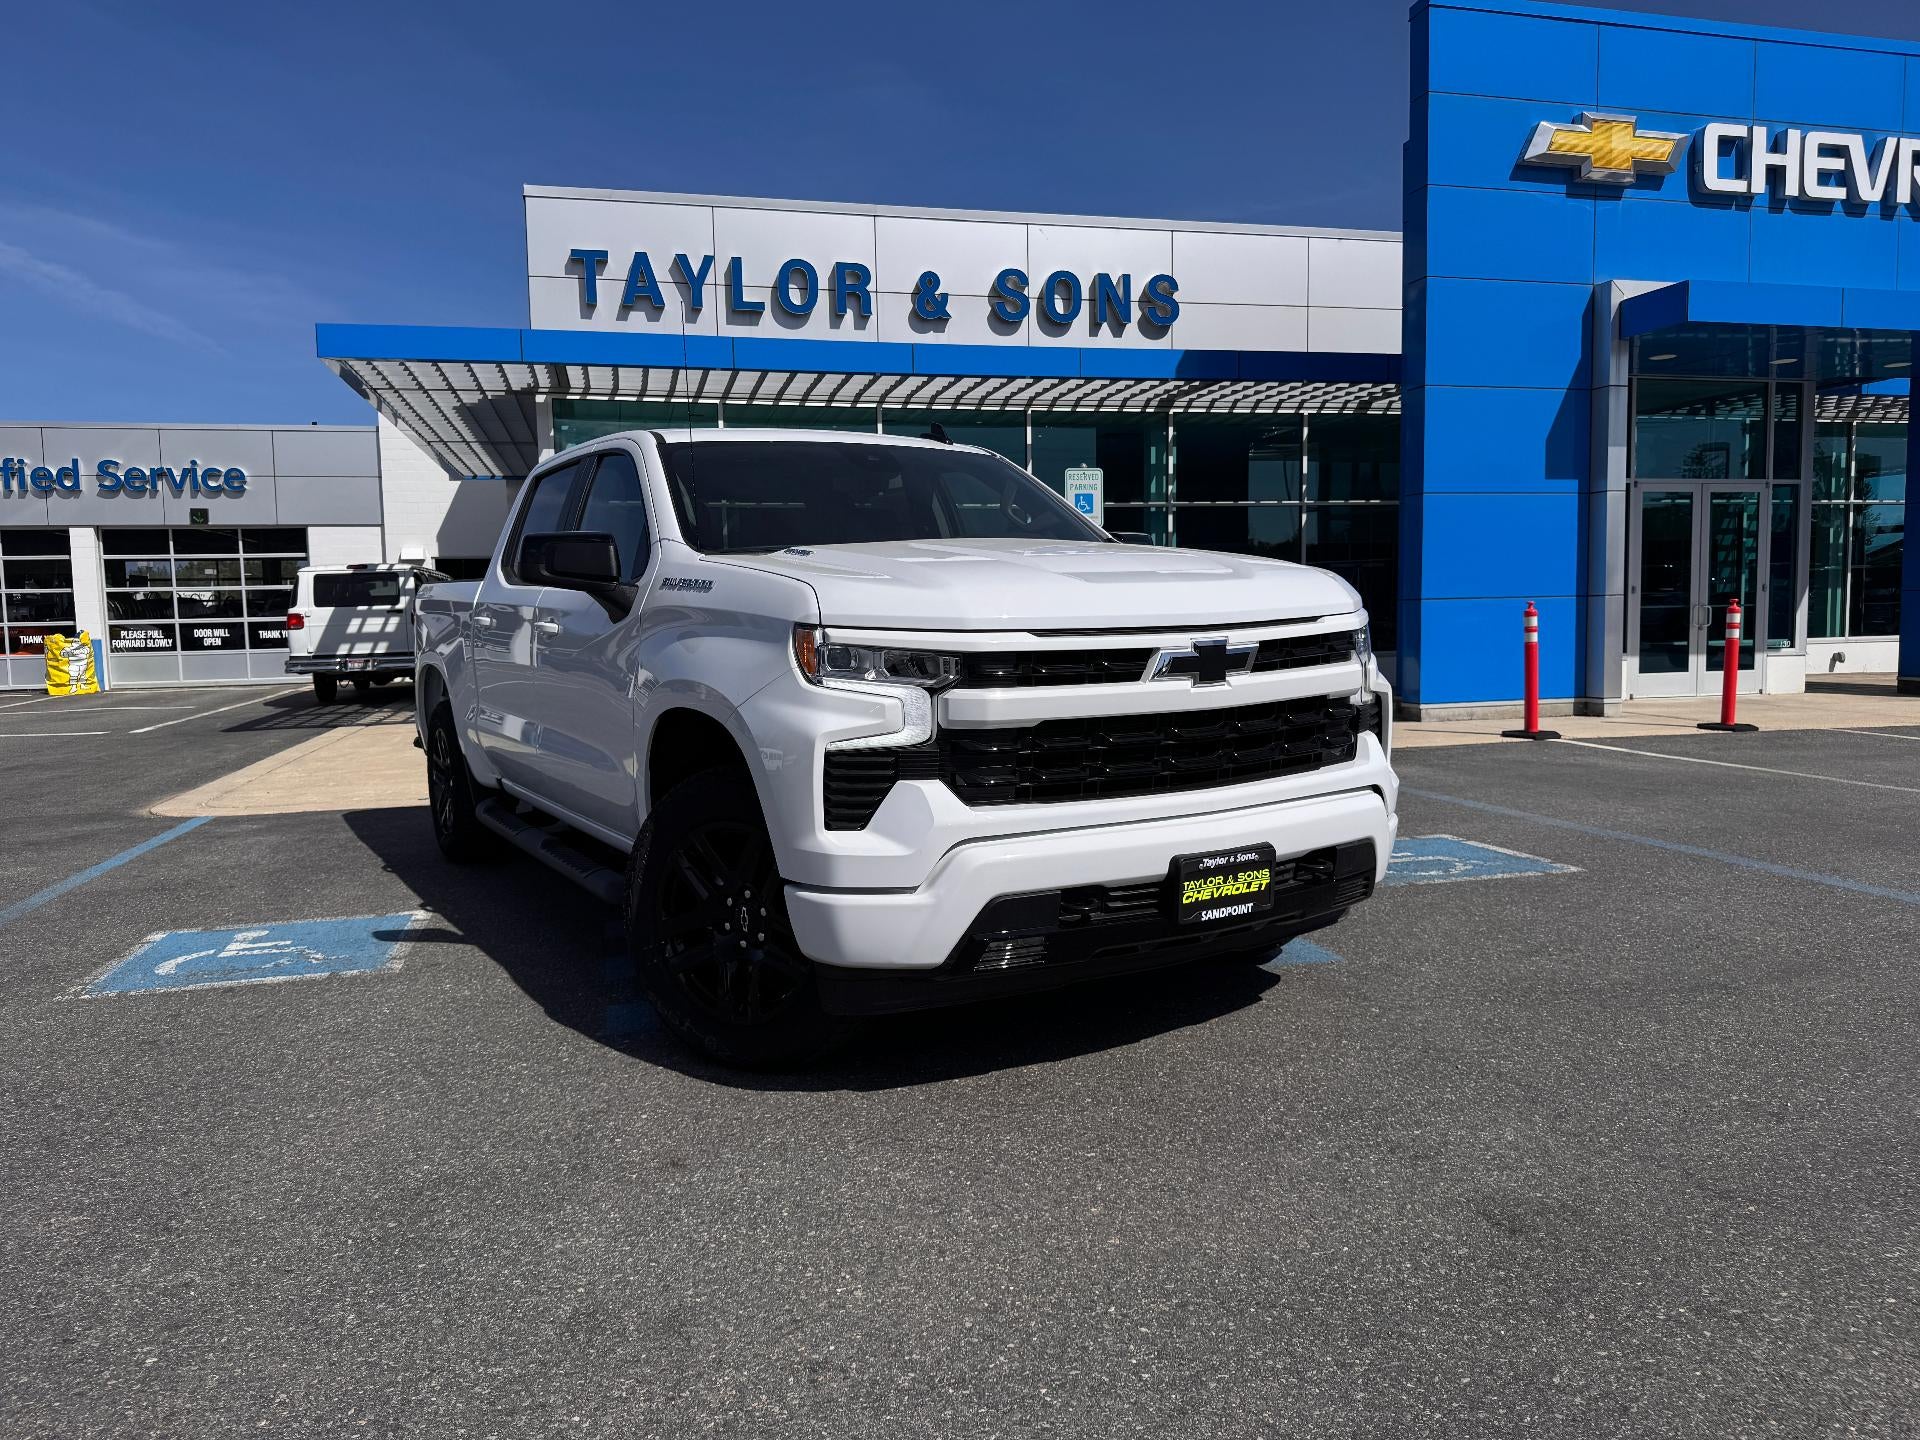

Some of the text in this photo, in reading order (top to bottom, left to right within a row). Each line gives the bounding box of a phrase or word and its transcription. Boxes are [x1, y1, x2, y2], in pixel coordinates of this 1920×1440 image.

[570, 249, 1180, 327] TAYLOR & SONS
[97, 459, 247, 491] Service
[1068, 473, 1100, 481] RESERVED
[1070, 483, 1098, 491] PARKING
[120, 629, 164, 639] PLEASE PULL
[193, 628, 230, 637] DOOR WILL
[258, 630, 281, 639] THANK
[19, 635, 43, 644] THANK
[112, 638, 173, 648] FORWARD SLOWLY
[203, 638, 221, 646] OPEN
[1202, 856, 1228, 868] Taylor
[1236, 852, 1256, 862] Sons
[1183, 868, 1270, 891] TAYLOR & SONS
[1182, 880, 1270, 904] CHEVROLET
[1201, 902, 1254, 921] SANDPOINT
